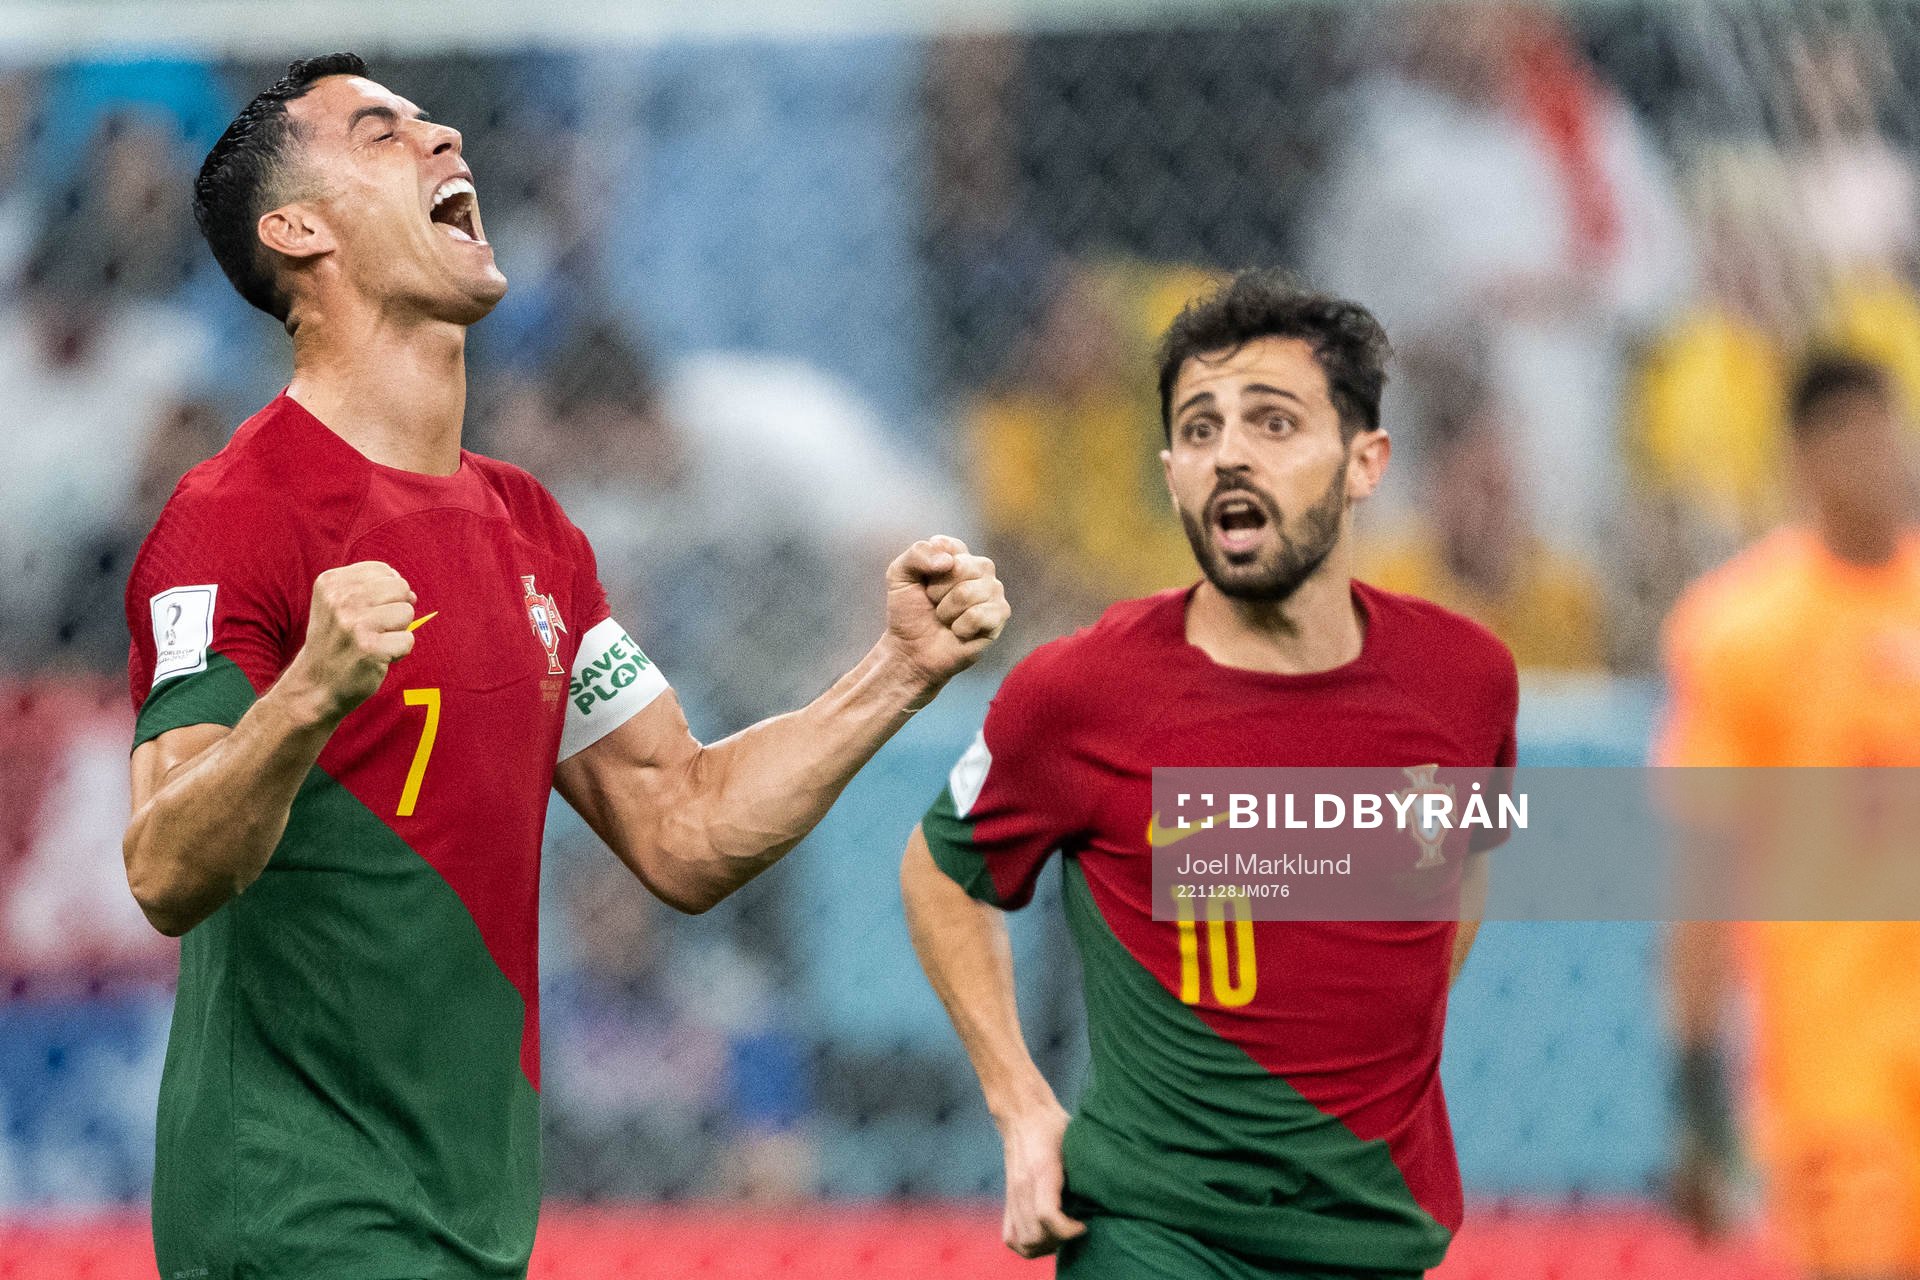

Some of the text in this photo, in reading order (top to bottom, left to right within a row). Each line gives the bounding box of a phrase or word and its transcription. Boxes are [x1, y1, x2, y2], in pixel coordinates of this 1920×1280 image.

[569, 642, 627, 695] SAVE
[396, 688, 441, 816] 7
[1171, 885, 1257, 1008] 10
